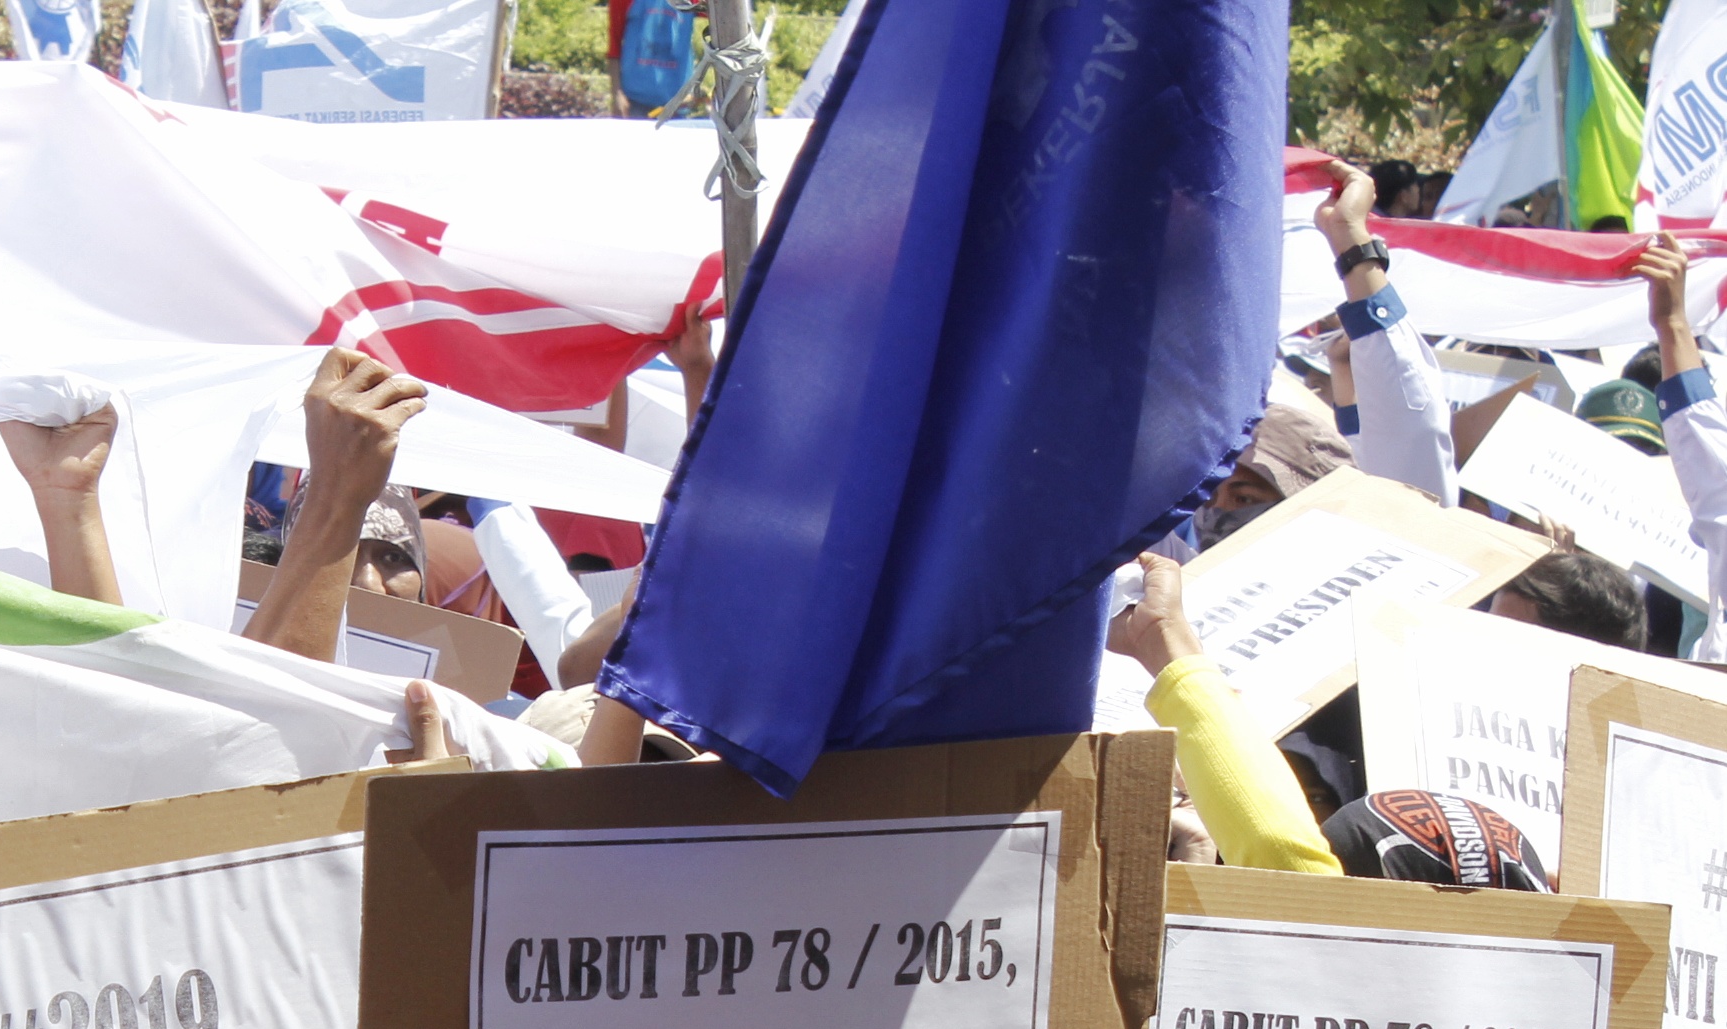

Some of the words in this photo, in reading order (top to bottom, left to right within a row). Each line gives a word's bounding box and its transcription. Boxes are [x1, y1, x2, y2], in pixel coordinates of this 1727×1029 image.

[1191, 580, 1275, 642] 2019
[1227, 547, 1407, 662] PRESIDEN
[1453, 701, 1536, 754] JAGA
[1384, 793, 1444, 841] CLES
[1447, 756, 1563, 816] PANGA
[505, 934, 667, 1003] CABUT
[682, 930, 754, 997] PP
[771, 927, 832, 993] 78
[847, 923, 880, 990] /
[895, 917, 1018, 989] 2015,
[1665, 944, 1718, 1025] NTI
